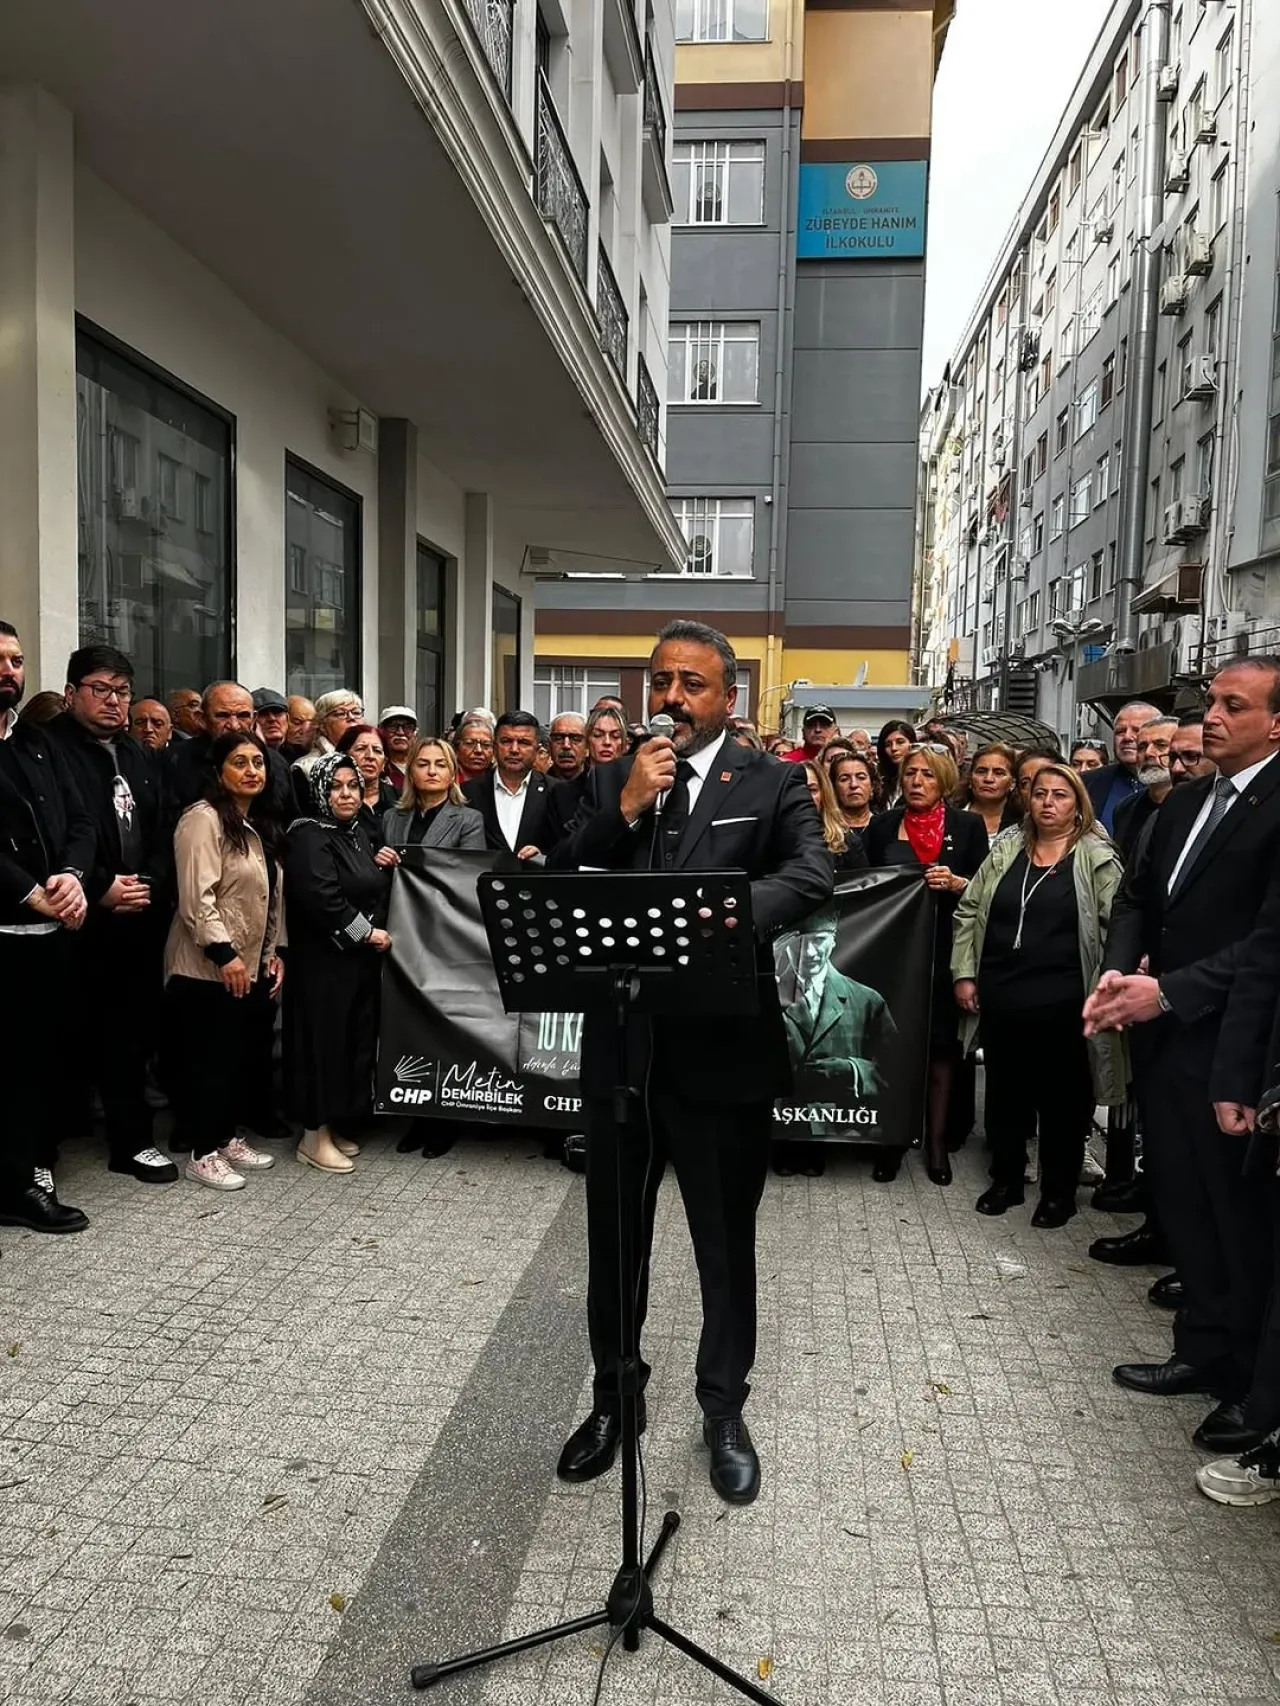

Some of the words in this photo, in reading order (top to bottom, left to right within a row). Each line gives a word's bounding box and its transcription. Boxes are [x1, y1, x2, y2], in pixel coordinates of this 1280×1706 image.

[805, 216, 867, 231] ZÜBEYDE
[872, 217, 916, 229] HANIM
[826, 235, 894, 249] İLKOKULU
[441, 1060, 524, 1093] Metin
[390, 1087, 432, 1105] CHP
[441, 1086, 524, 1106] DEMİRBİLEK
[543, 1095, 583, 1112] CHP
